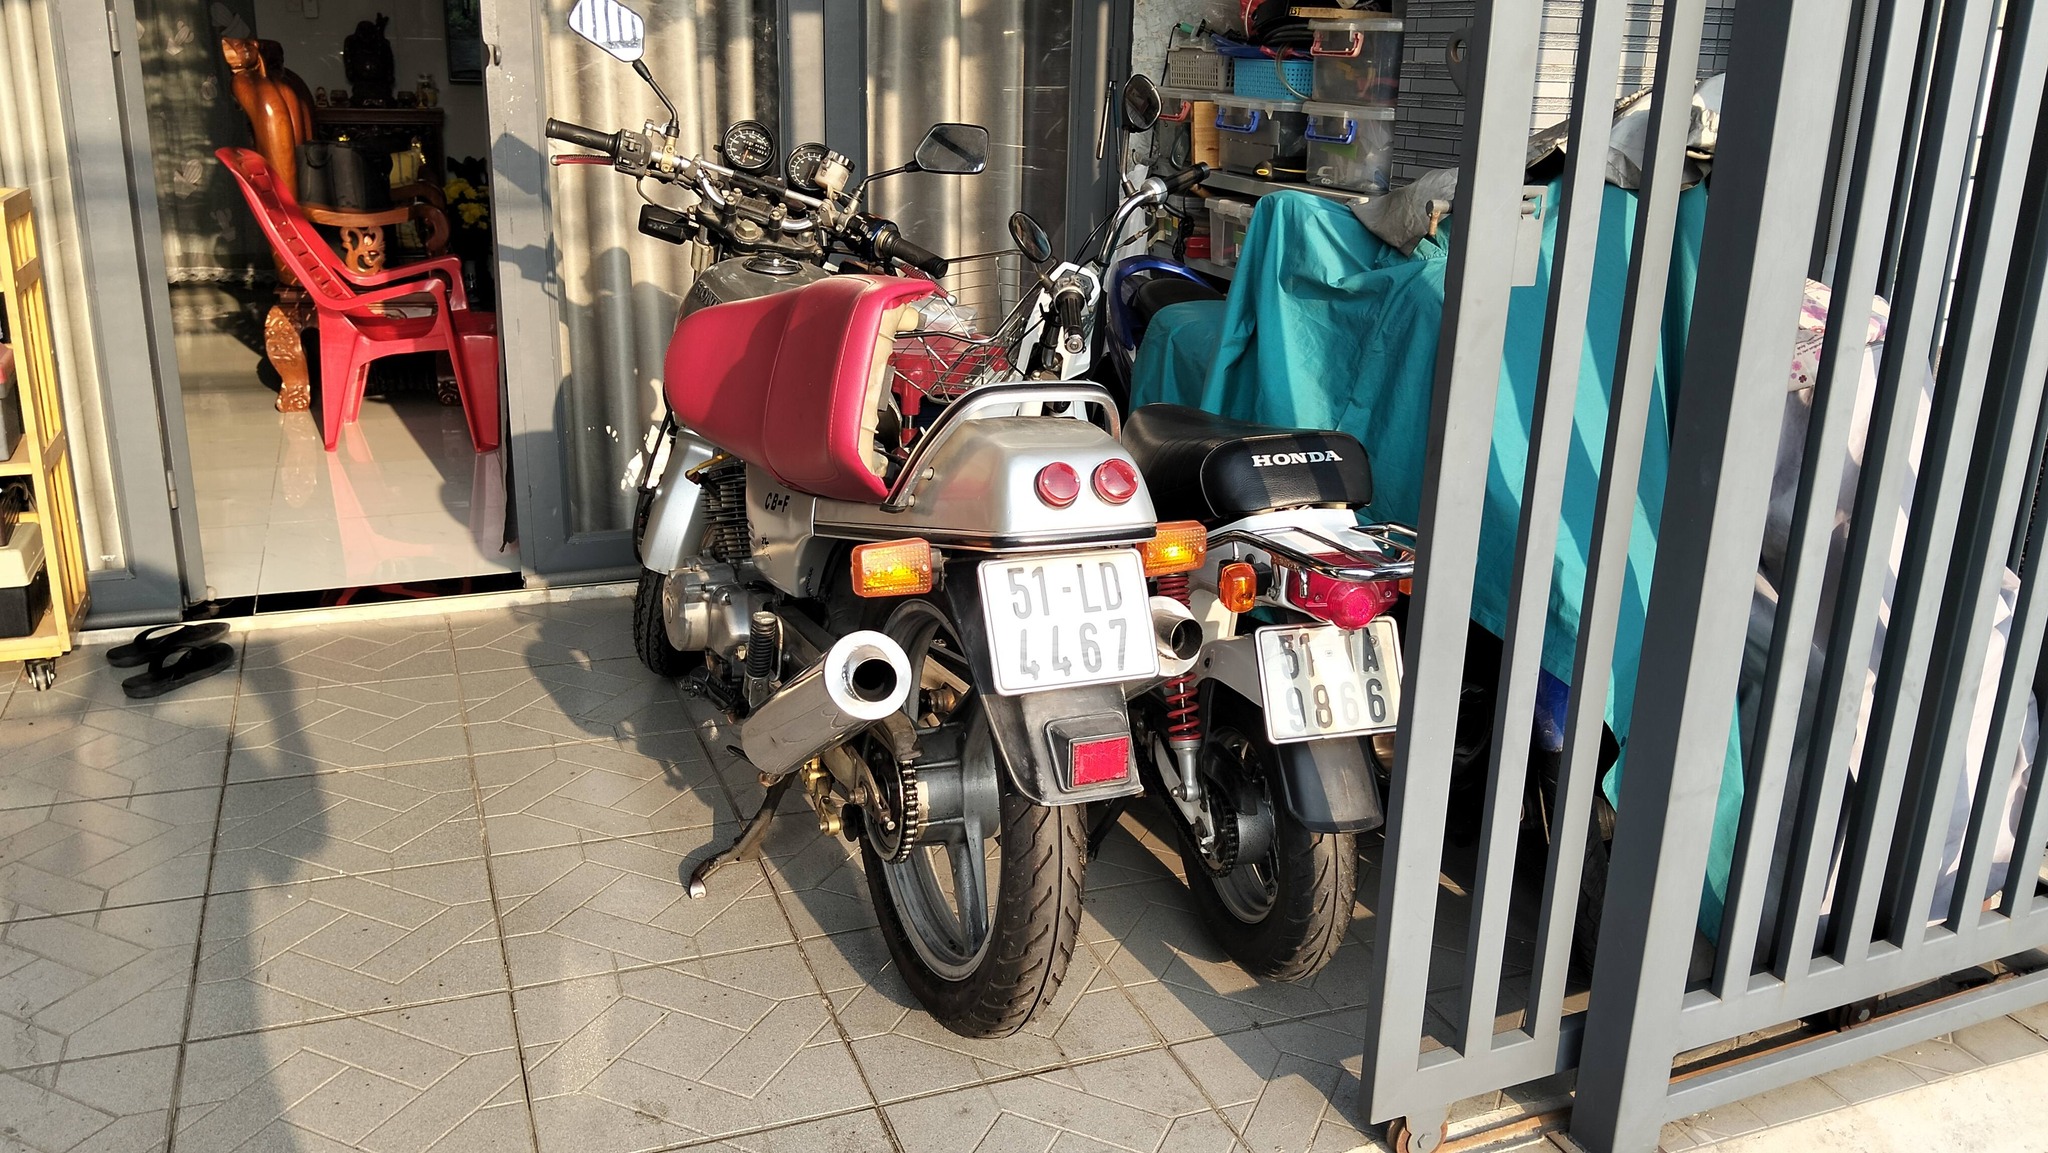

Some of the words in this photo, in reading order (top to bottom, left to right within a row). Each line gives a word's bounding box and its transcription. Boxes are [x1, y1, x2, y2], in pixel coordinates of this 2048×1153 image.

[1251, 450, 1343, 467] HONDA
[765, 492, 790, 512] CB-F
[1007, 561, 1123, 620] 51-LD
[1019, 617, 1127, 681] 4467
[1285, 677, 1387, 732] 9866
